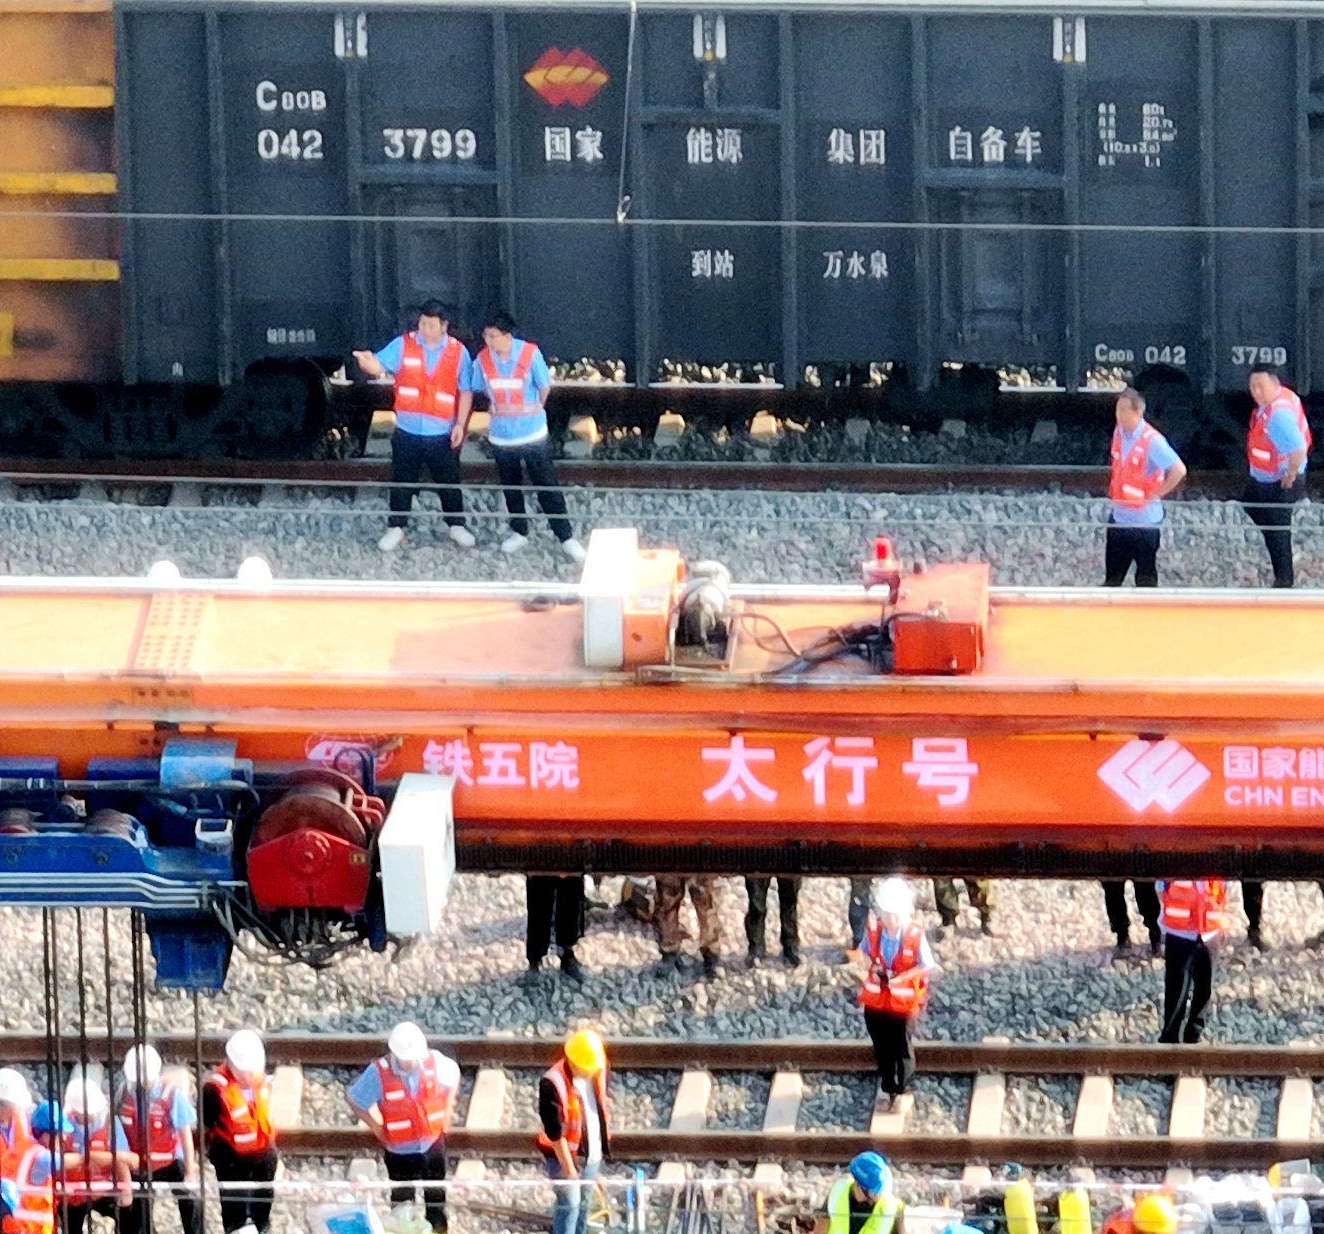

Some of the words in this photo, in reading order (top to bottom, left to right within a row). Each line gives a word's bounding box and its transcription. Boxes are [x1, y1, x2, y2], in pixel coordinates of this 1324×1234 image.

[257, 128, 323, 160] 042
[382, 128, 477, 159] 3799
[544, 126, 603, 162] 国家
[686, 128, 743, 164] 能源
[828, 128, 885, 165] 集团
[949, 125, 1042, 163] 自备车
[691, 249, 734, 278] 到站
[823, 250, 889, 279] 万水泉
[1145, 345, 1186, 364] 042
[701, 736, 979, 806] 太行号
[1224, 785, 1284, 806] CHN
